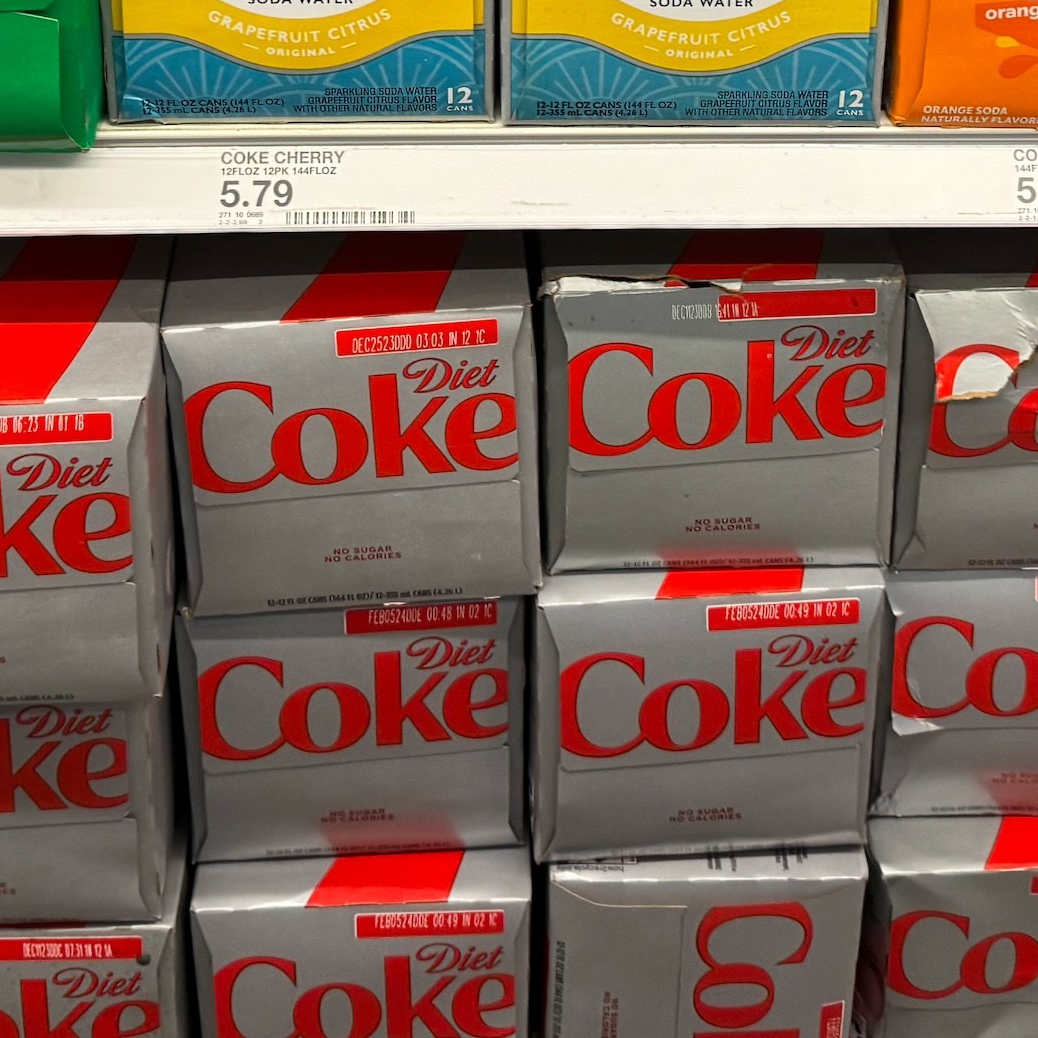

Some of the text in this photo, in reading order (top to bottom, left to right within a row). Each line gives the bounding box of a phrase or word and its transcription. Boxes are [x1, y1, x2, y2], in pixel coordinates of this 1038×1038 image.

[207, 8, 392, 43] GRAPEFRUIT CITRUS
[611, 10, 792, 46] GRAPEFRUIT CITRUS
[985, 5, 1038, 22] orang
[923, 105, 1009, 117] ORANGE SODA
[221, 151, 345, 165] COKE CHERRY
[221, 167, 337, 176] 12FLOZ 12PK 144FLOZ
[219, 179, 294, 208] 5.79
[781, 325, 876, 362] Diet
[402, 357, 500, 394] Diet
[568, 340, 886, 457] Coke
[183, 373, 519, 494] Coke
[6, 453, 112, 491] Diet
[406, 636, 498, 670] Diet
[768, 634, 858, 667] Diet
[197, 650, 509, 761] Coke
[559, 648, 867, 758] Coke
[15, 705, 113, 738] Diet
[416, 942, 504, 974] Diet
[52, 967, 143, 999] Diet
